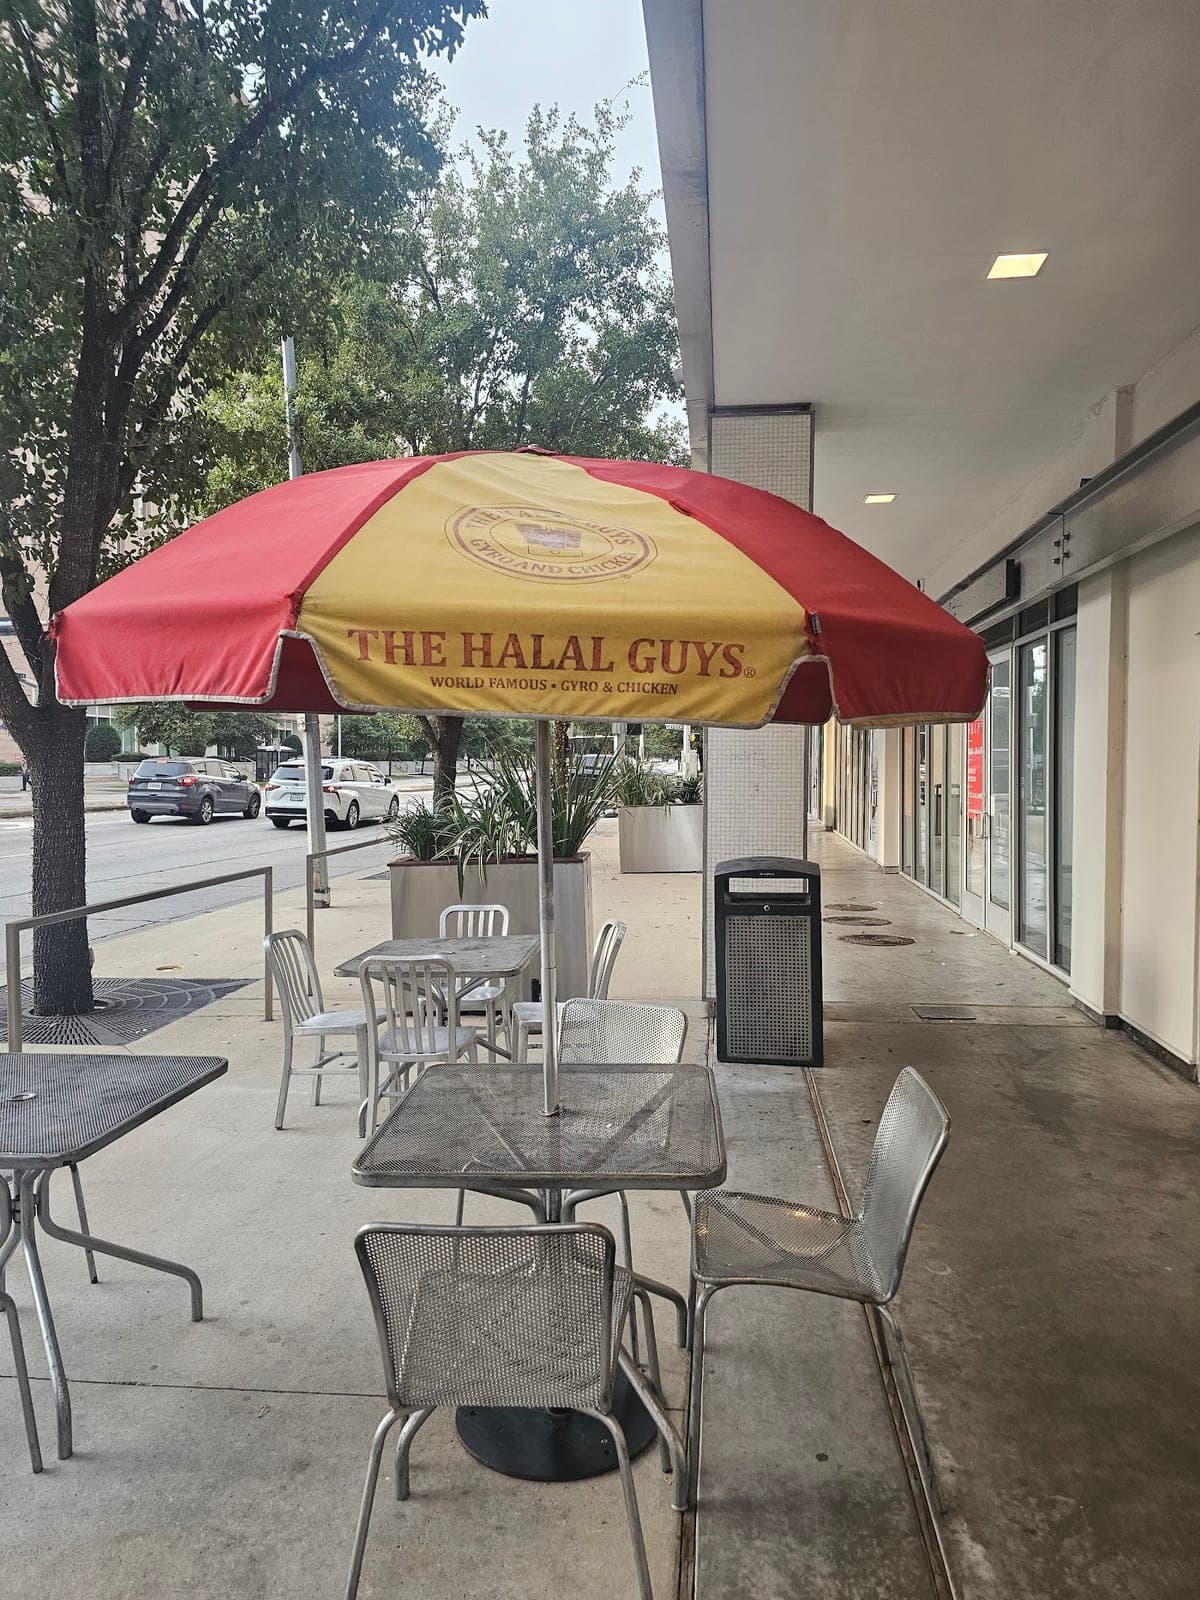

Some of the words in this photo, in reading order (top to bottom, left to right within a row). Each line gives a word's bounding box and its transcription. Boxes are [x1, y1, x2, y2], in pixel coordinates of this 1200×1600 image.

[465, 510, 501, 529] THE
[471, 539, 514, 563] GYRO
[513, 561, 564, 575] AND
[347, 629, 447, 667] THE
[460, 632, 615, 672] HALAL
[430, 676, 484, 689] WORLD
[489, 677, 547, 690] FAMOUS
[561, 680, 598, 692] GYRO
[602, 682, 613, 692] &
[617, 682, 678, 695] CHICKEN
